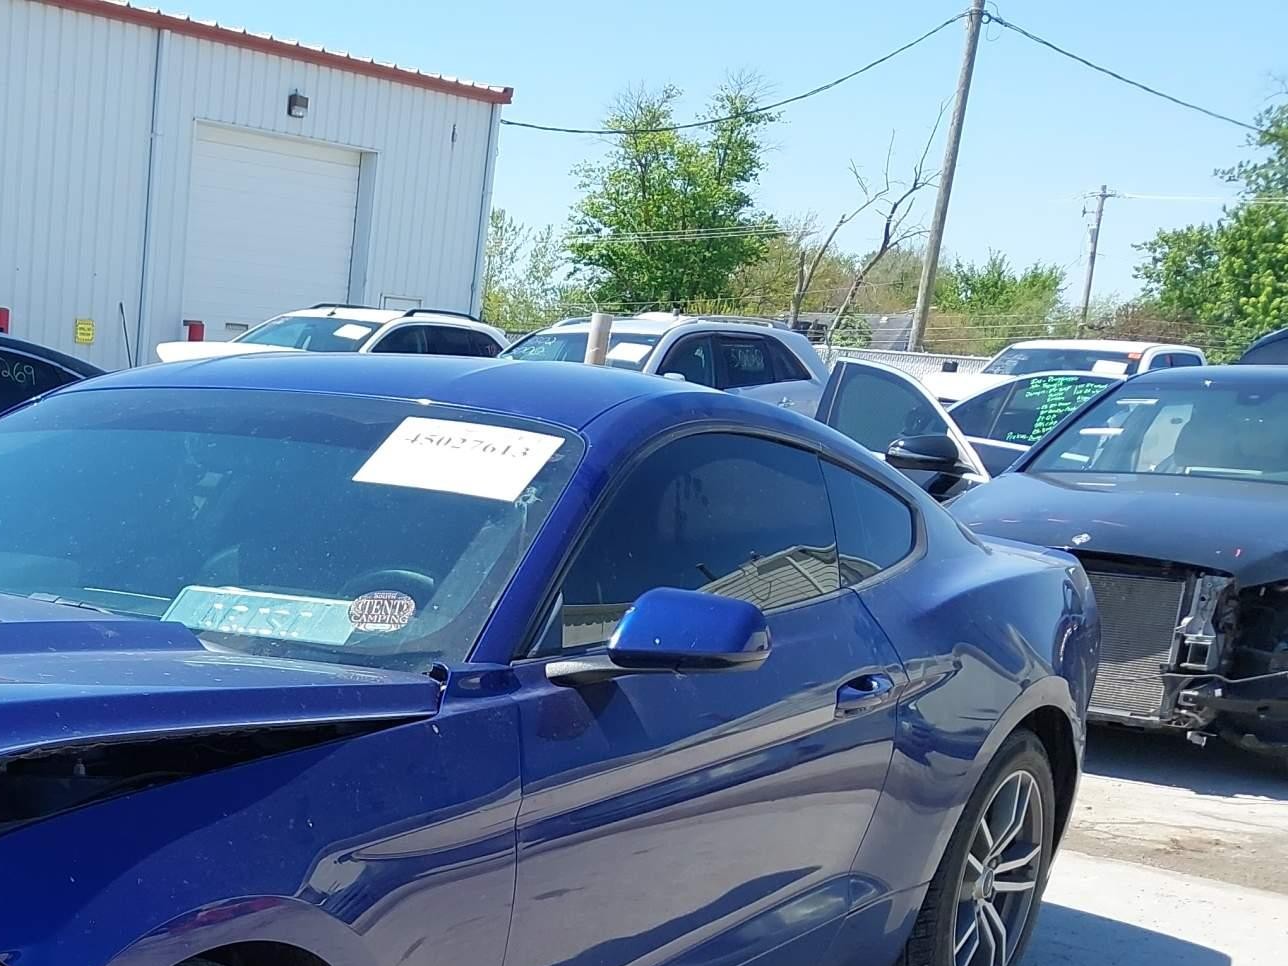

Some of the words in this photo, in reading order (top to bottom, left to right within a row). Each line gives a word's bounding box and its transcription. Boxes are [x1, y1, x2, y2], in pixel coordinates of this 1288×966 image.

[406, 433, 531, 458] 45027613
[363, 599, 405, 615] TENT
[351, 613, 410, 624] CAMPING
